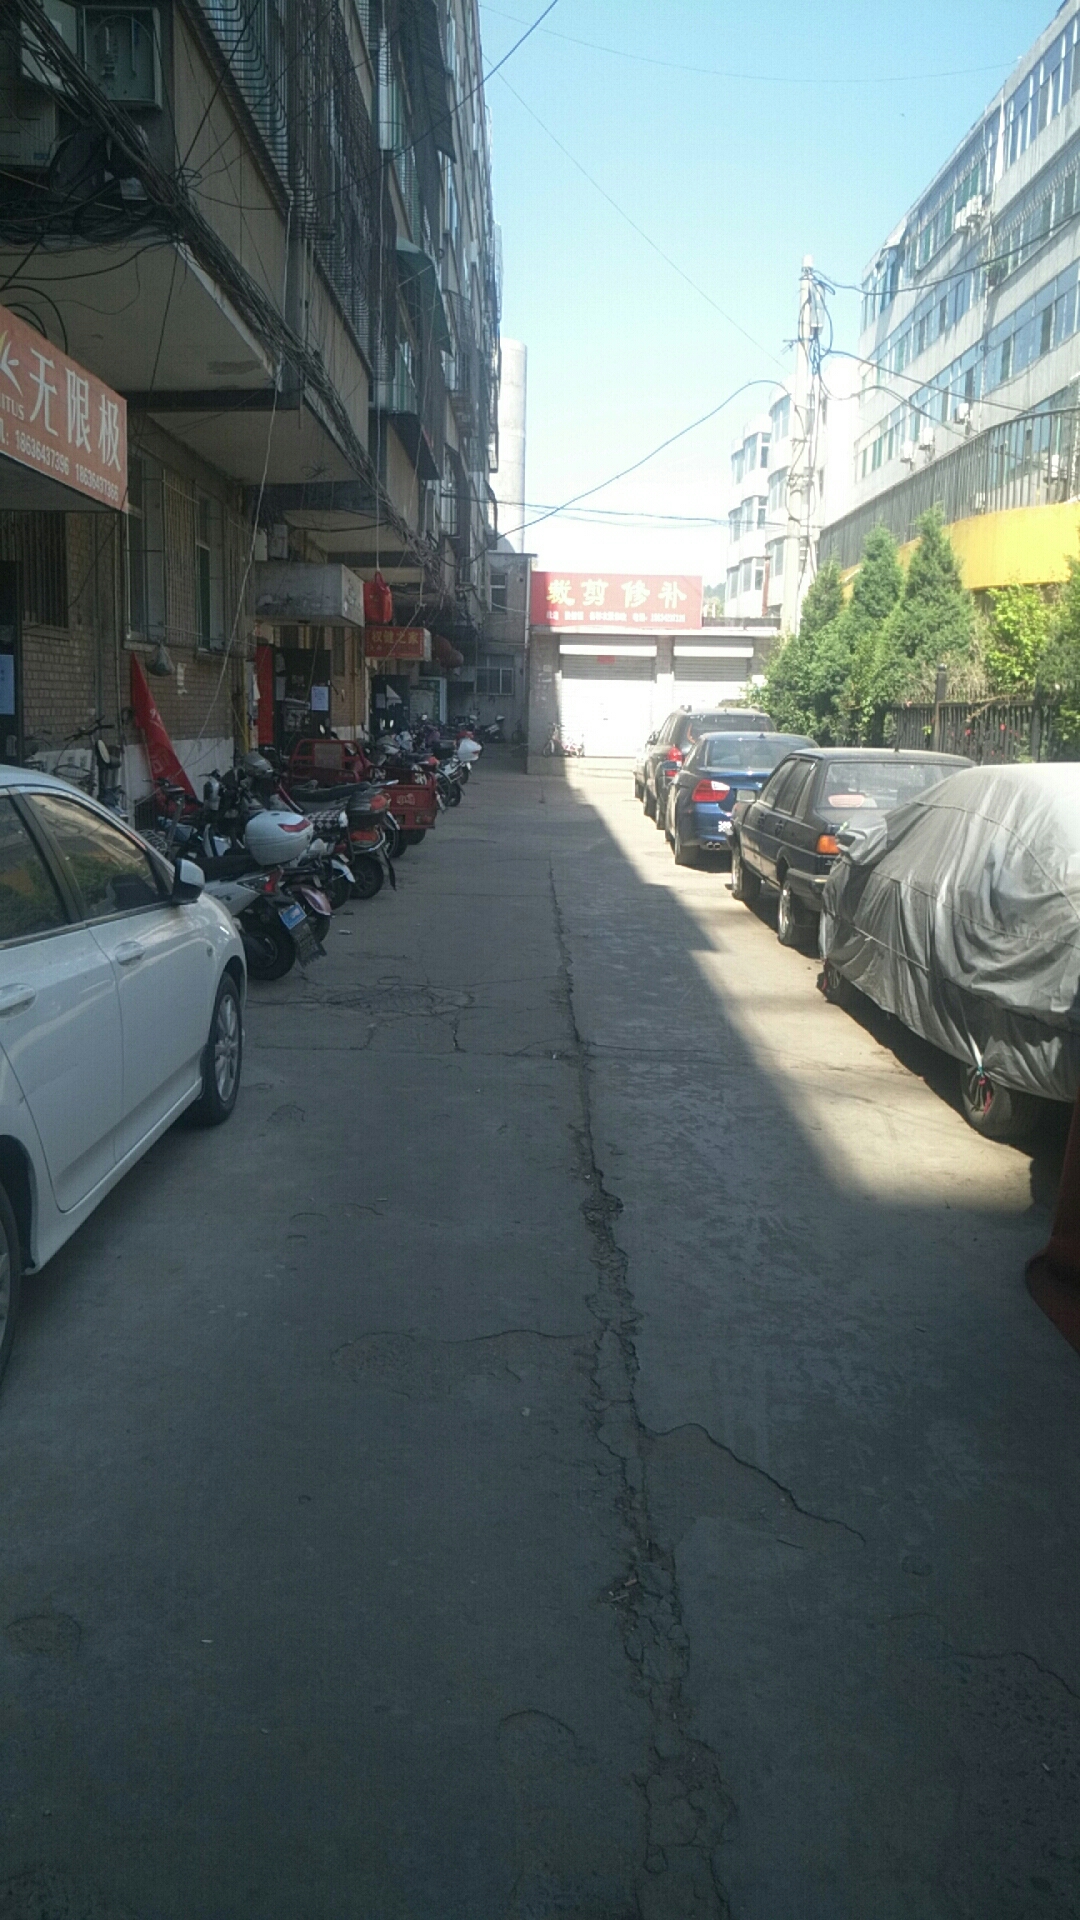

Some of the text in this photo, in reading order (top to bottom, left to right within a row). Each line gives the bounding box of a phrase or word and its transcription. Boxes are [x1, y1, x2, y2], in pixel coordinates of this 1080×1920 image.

[29, 347, 121, 472] 无限极
[546, 578, 687, 609] 裁剪修补
